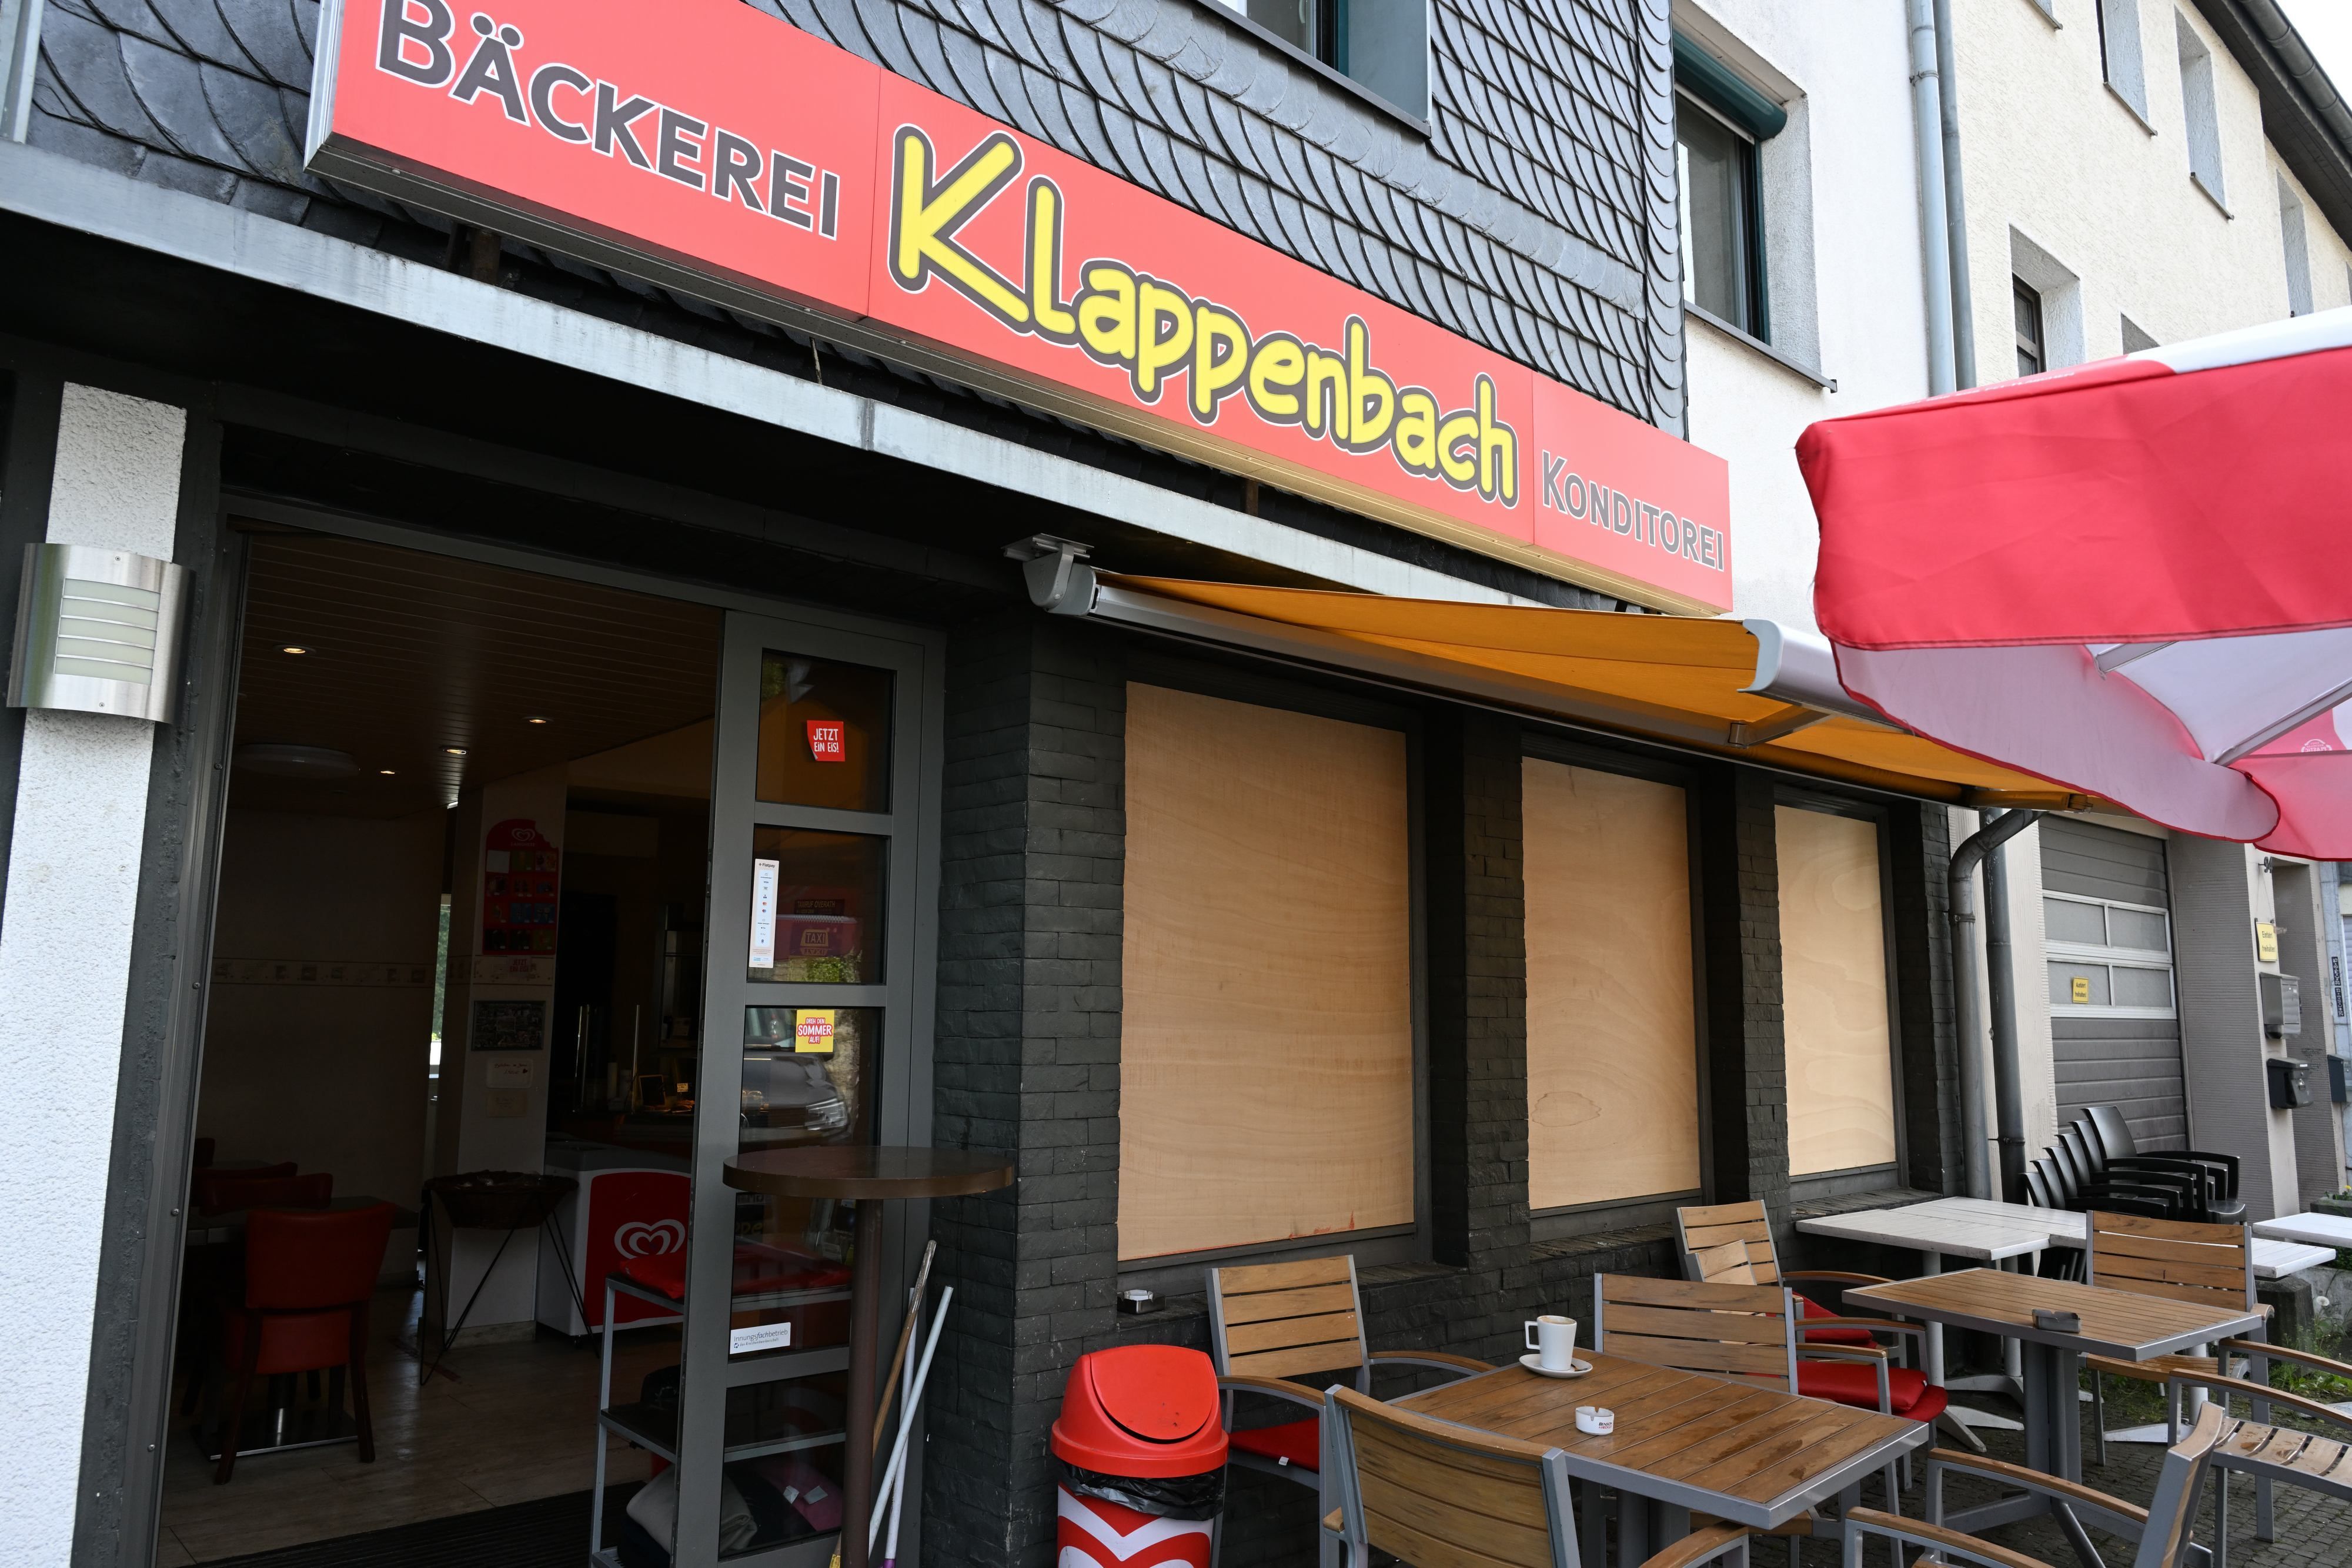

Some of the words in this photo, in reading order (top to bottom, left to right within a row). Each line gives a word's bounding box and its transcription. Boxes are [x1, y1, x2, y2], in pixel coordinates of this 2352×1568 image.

[376, 0, 840, 240] BÄCKEREI
[888, 124, 1519, 508] Klappenbach
[1542, 449, 1724, 571] KONDITOREI
[813, 728, 838, 741] JETZT
[2264, 856, 2273, 874] 94
[806, 932, 825, 944] TAXI
[798, 1025, 832, 1035] SOMMER
[734, 1329, 788, 1342] Innungsfachbetrieb
